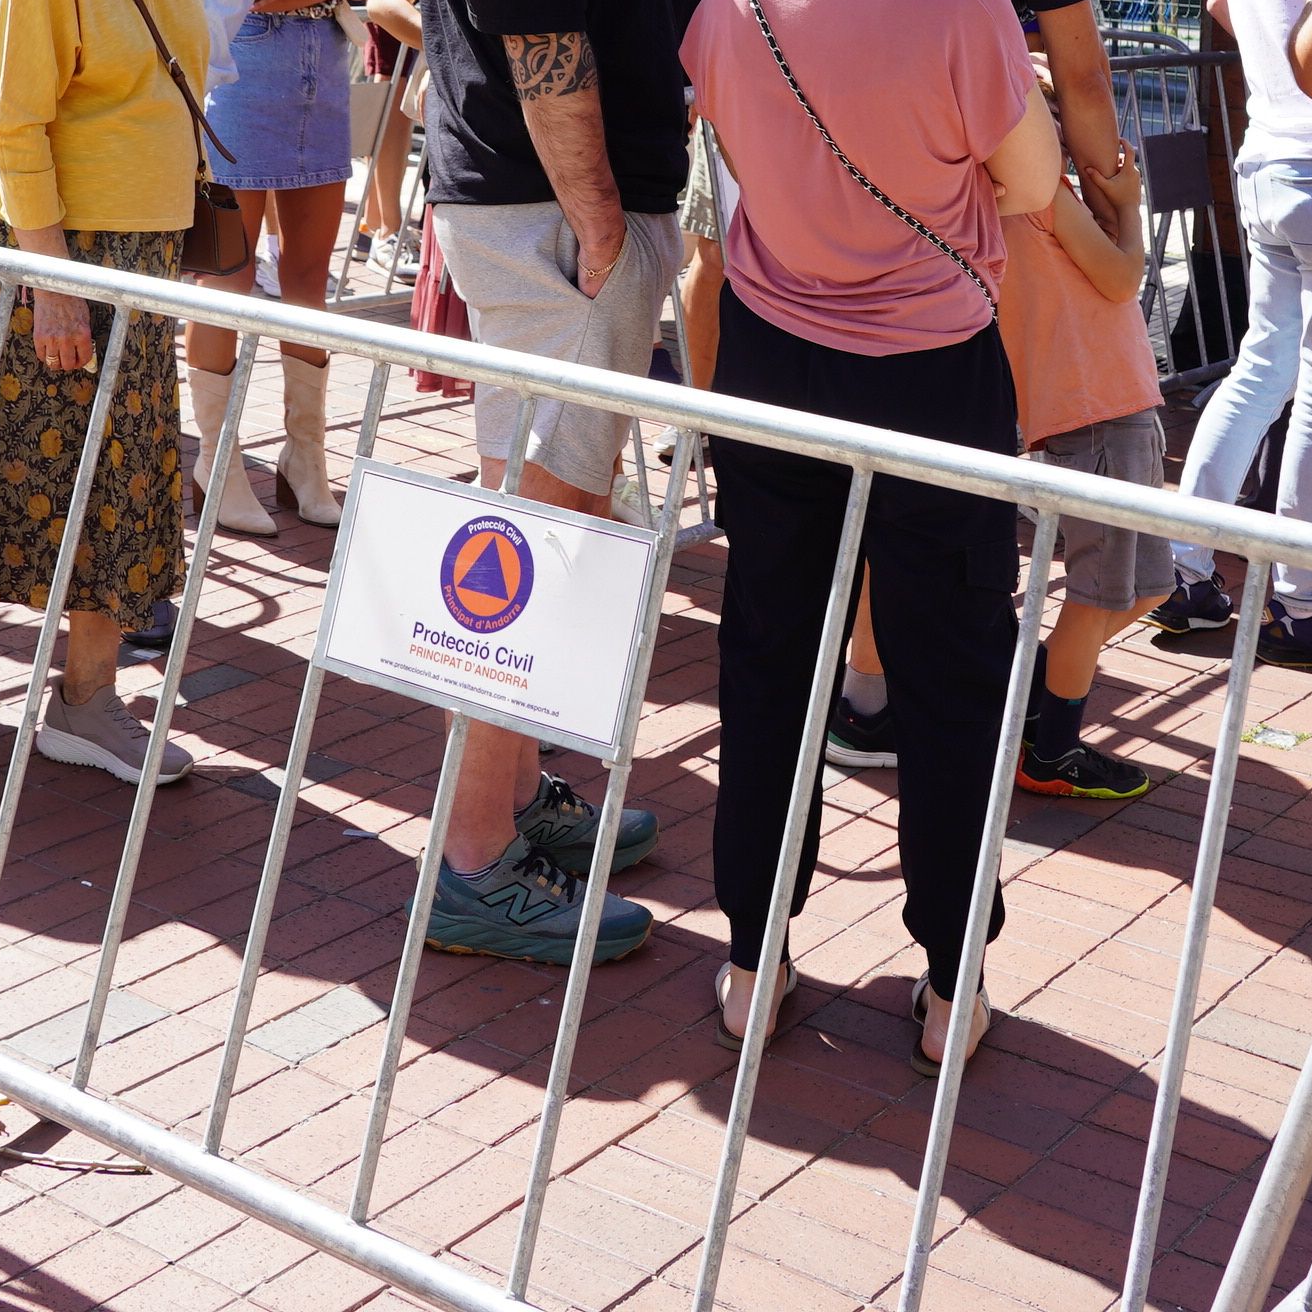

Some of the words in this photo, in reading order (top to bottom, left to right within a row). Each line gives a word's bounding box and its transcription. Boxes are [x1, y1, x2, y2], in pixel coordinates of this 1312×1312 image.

[467, 520, 506, 535] Protecció
[505, 527, 523, 546] Civil
[444, 584, 473, 627] Principat
[475, 603, 522, 630] d'Andorra
[409, 644, 463, 670] PRINCIPAT
[464, 661, 529, 690] D'ANDORRA
[412, 621, 490, 660] Protecció
[495, 646, 534, 673] Civil
[511, 698, 560, 718] www.esports.ad
